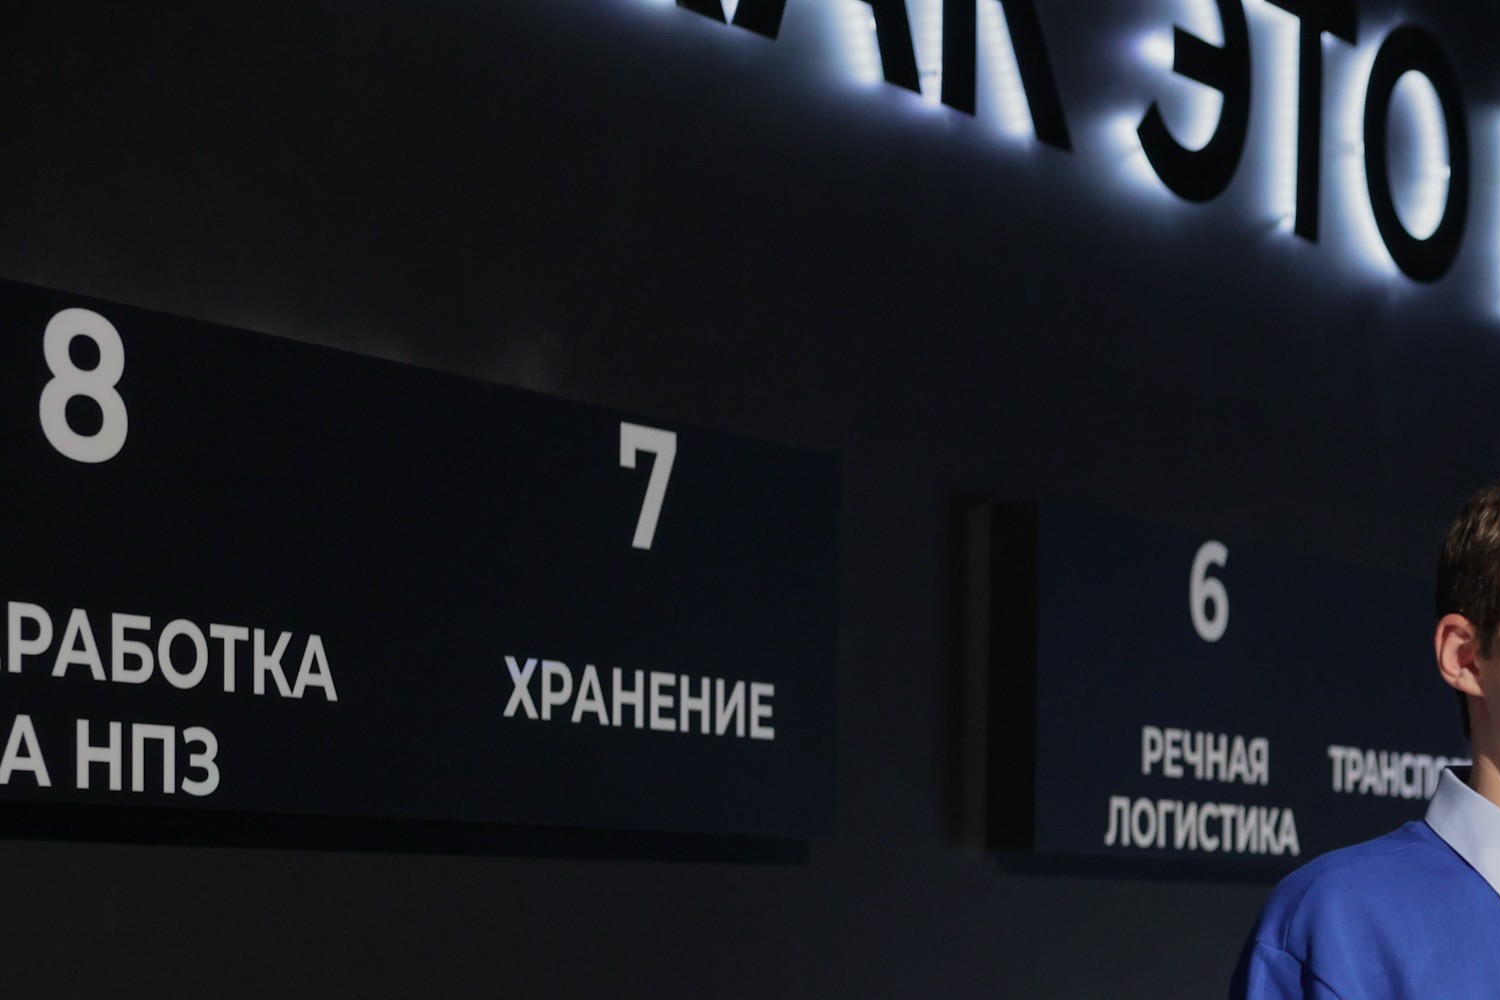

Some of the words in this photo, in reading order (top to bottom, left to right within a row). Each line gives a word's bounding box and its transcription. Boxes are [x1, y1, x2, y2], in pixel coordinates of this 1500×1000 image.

[1136, 0, 1470, 284] ЭТО
[38, 307, 129, 464] 8
[619, 421, 678, 550] 7
[1189, 540, 1230, 642] 6
[503, 655, 776, 740] ХРАНЕНИЕ
[76, 718, 220, 797] НПЗ
[1141, 725, 1269, 786] РЕЧНАЯ
[1104, 796, 1300, 857] ЛОГИСТИКА
